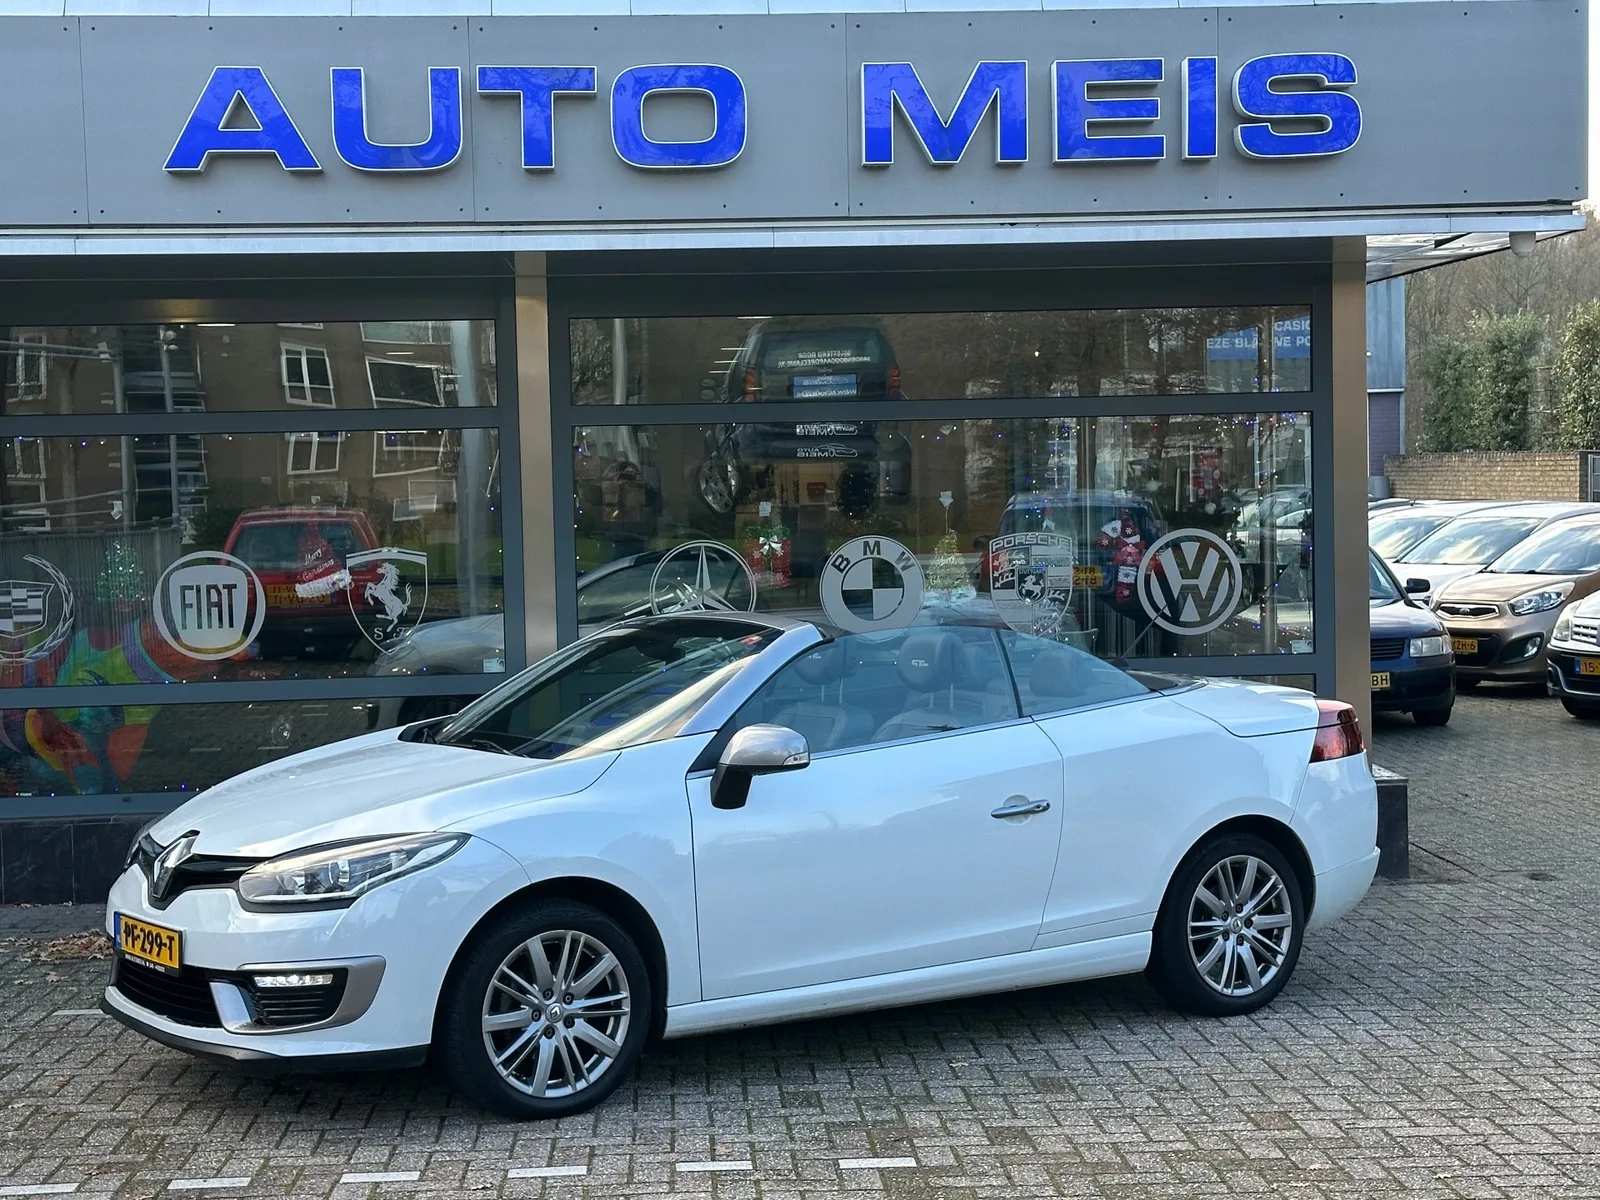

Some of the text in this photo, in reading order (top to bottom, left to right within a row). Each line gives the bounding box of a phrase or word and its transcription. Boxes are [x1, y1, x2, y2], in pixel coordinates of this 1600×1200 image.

[163, 52, 1363, 173] AUTO MEIS
[830, 540, 917, 574] BMW
[992, 534, 1070, 552] PORSCHE
[179, 583, 238, 630] FIAT
[123, 921, 175, 962] PF-299-T
